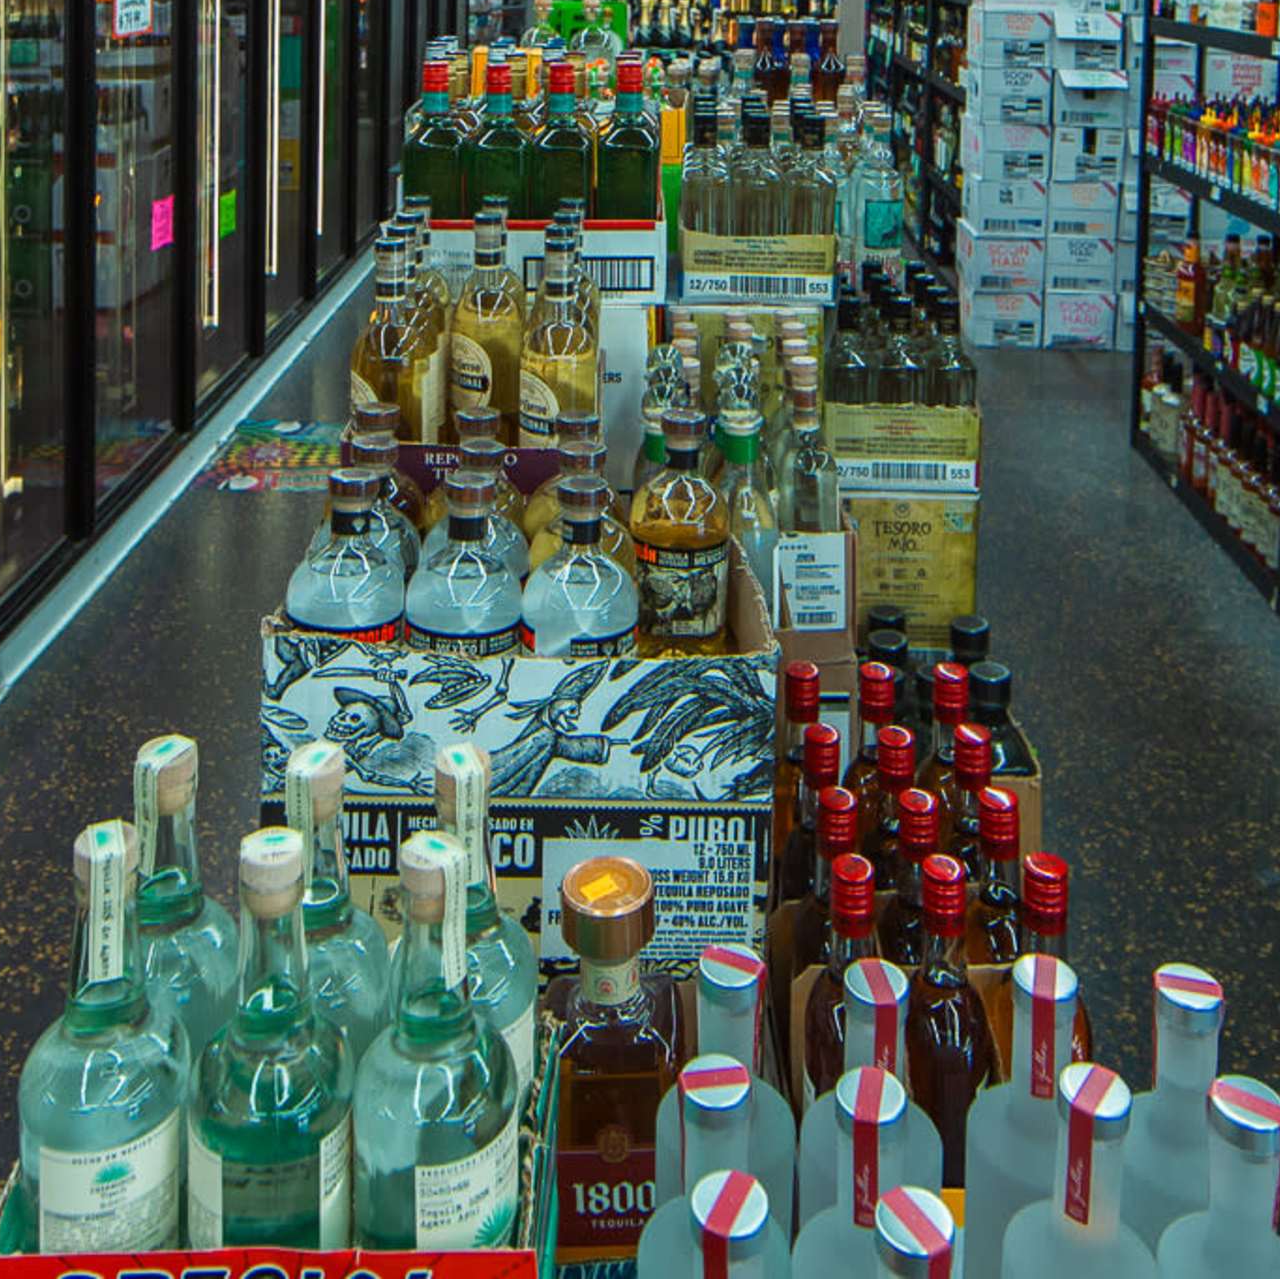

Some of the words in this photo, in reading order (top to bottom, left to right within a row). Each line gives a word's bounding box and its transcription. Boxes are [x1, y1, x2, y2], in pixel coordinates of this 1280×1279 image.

[833, 466, 869, 477] 2/750
[873, 520, 932, 538] TESORO
[342, 812, 390, 841] UILA
[408, 817, 438, 830] HECH
[694, 843, 706, 856] 12
[715, 843, 734, 856] 750
[717, 858, 751, 870] LITERS
[673, 871, 711, 883] WEIGHT
[654, 885, 693, 898] TEQUILA
[696, 886, 750, 898] REPOSADO
[655, 900, 684, 913] 100%
[686, 901, 714, 913] PURO
[716, 901, 749, 913] AGAVE
[572, 1180, 656, 1216] 1800
